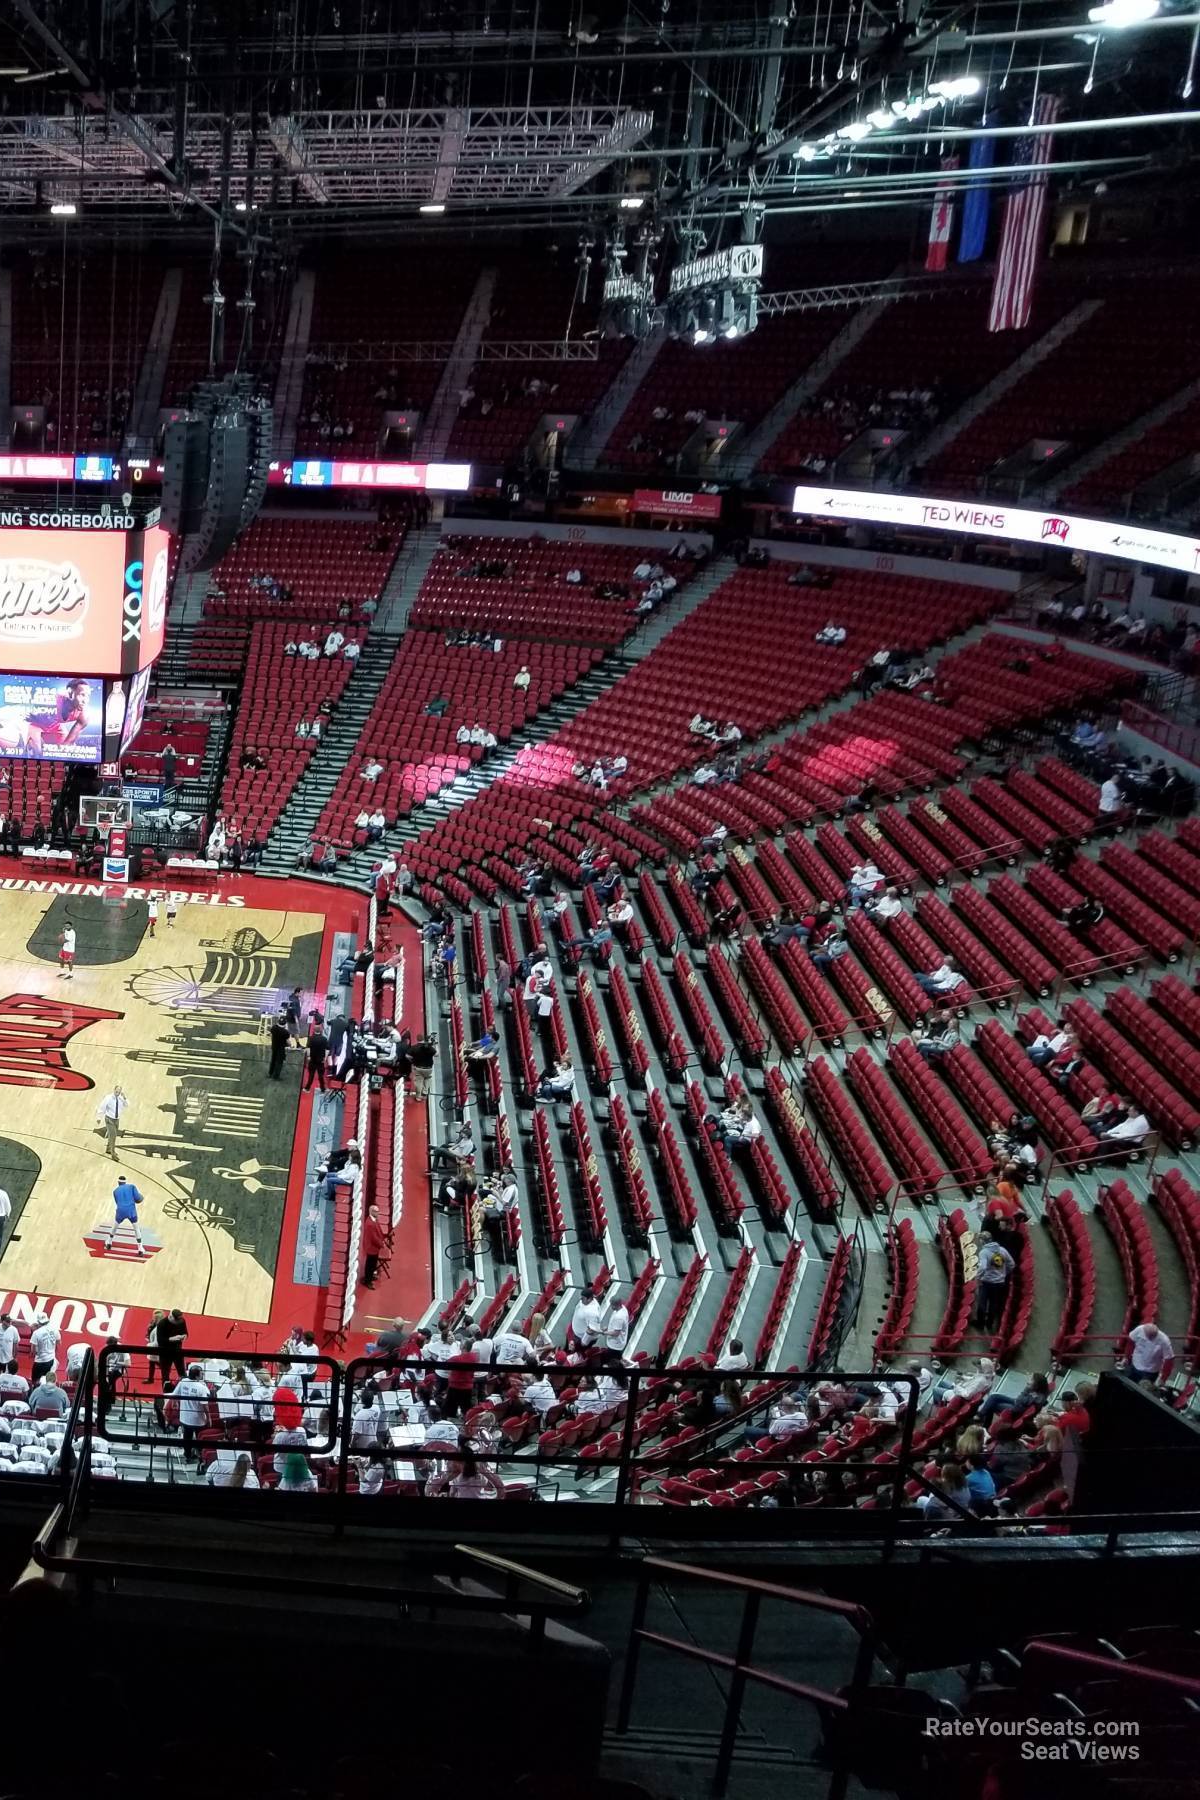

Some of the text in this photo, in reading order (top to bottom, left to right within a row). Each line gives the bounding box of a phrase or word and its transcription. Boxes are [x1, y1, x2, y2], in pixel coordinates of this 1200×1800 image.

[661, 490, 695, 504] UMC
[29, 512, 135, 529] SCOREBOARD
[922, 505, 950, 526] TED
[953, 508, 1005, 529] WIENS
[566, 527, 585, 539] 102
[874, 554, 895, 571] 103
[122, 561, 144, 642] COX
[5, 747, 24, 756] 2019
[103, 763, 117, 776] 30
[117, 887, 246, 907] REBELS
